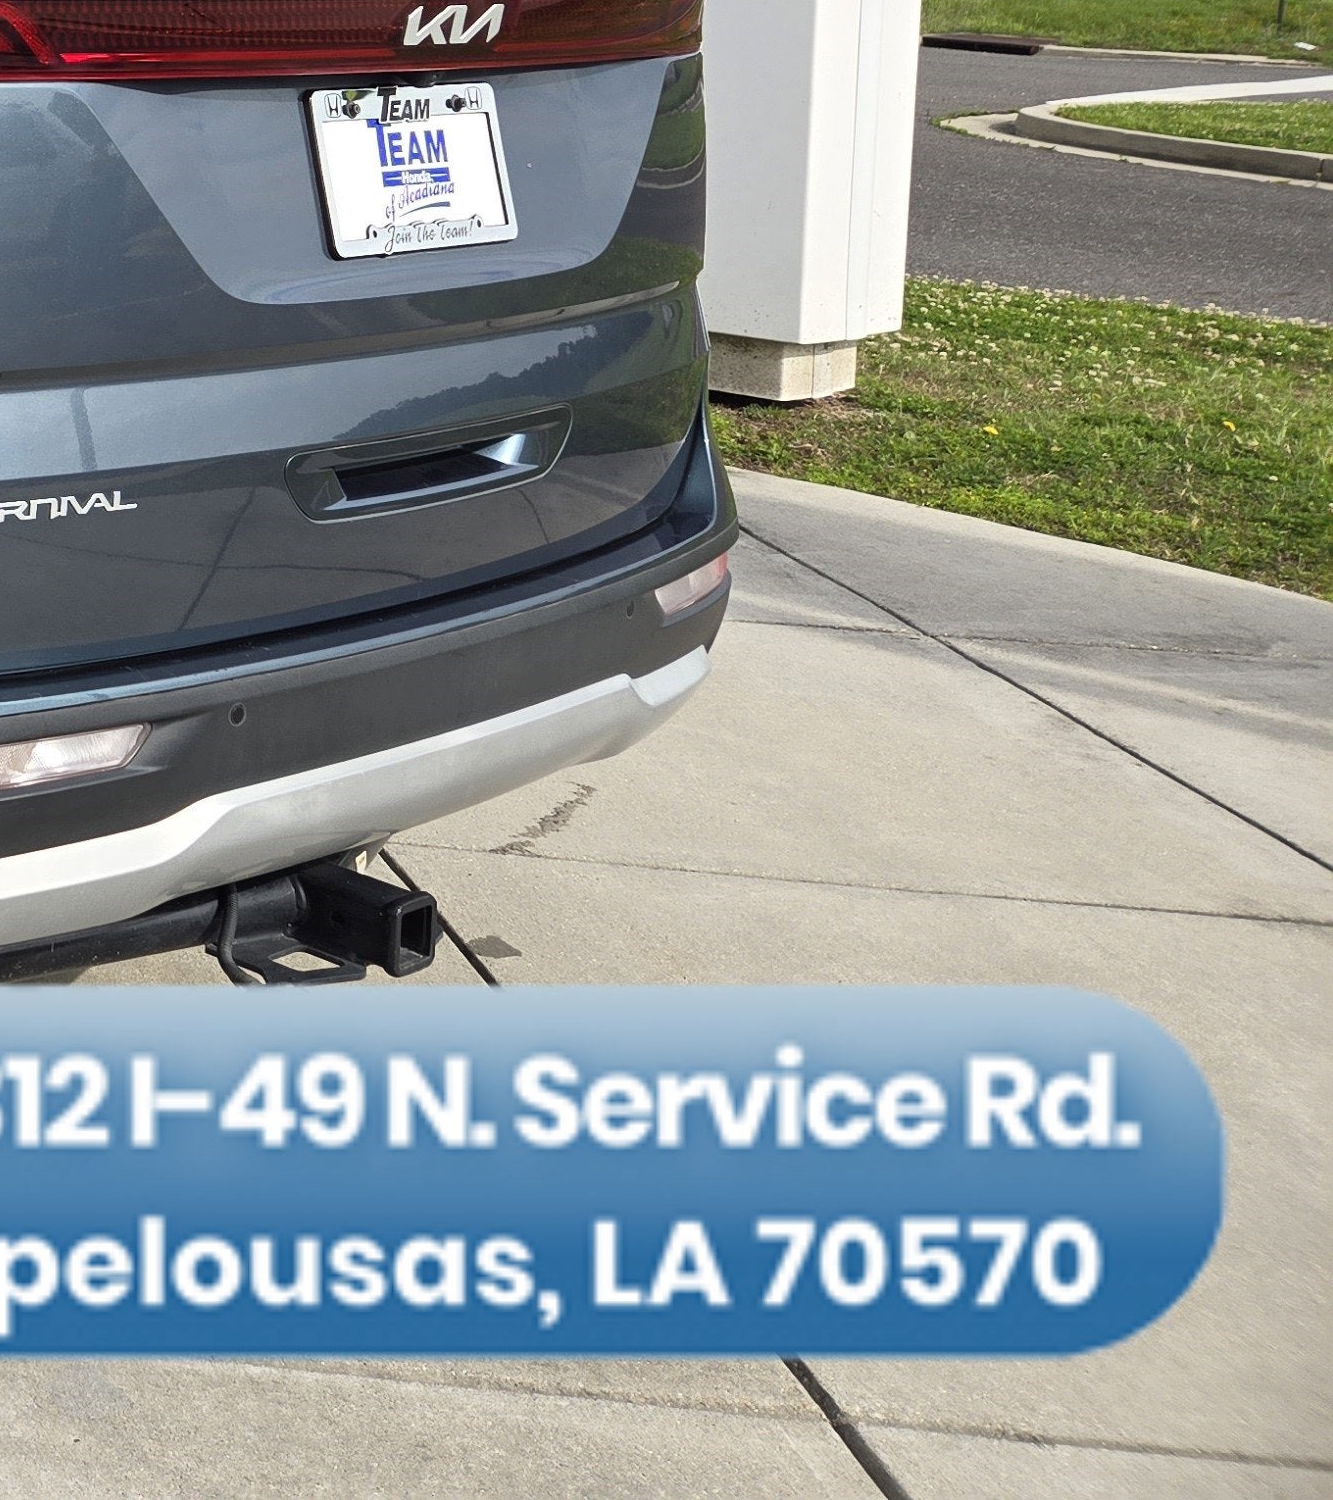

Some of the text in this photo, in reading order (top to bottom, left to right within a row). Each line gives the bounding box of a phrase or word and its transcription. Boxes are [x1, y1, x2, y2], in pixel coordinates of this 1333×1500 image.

[377, 87, 430, 122] TEAM
[366, 118, 449, 167] TEAM
[401, 172, 432, 183] Honda
[385, 181, 455, 220] of Acadiana
[384, 220, 473, 253] Join The Team!
